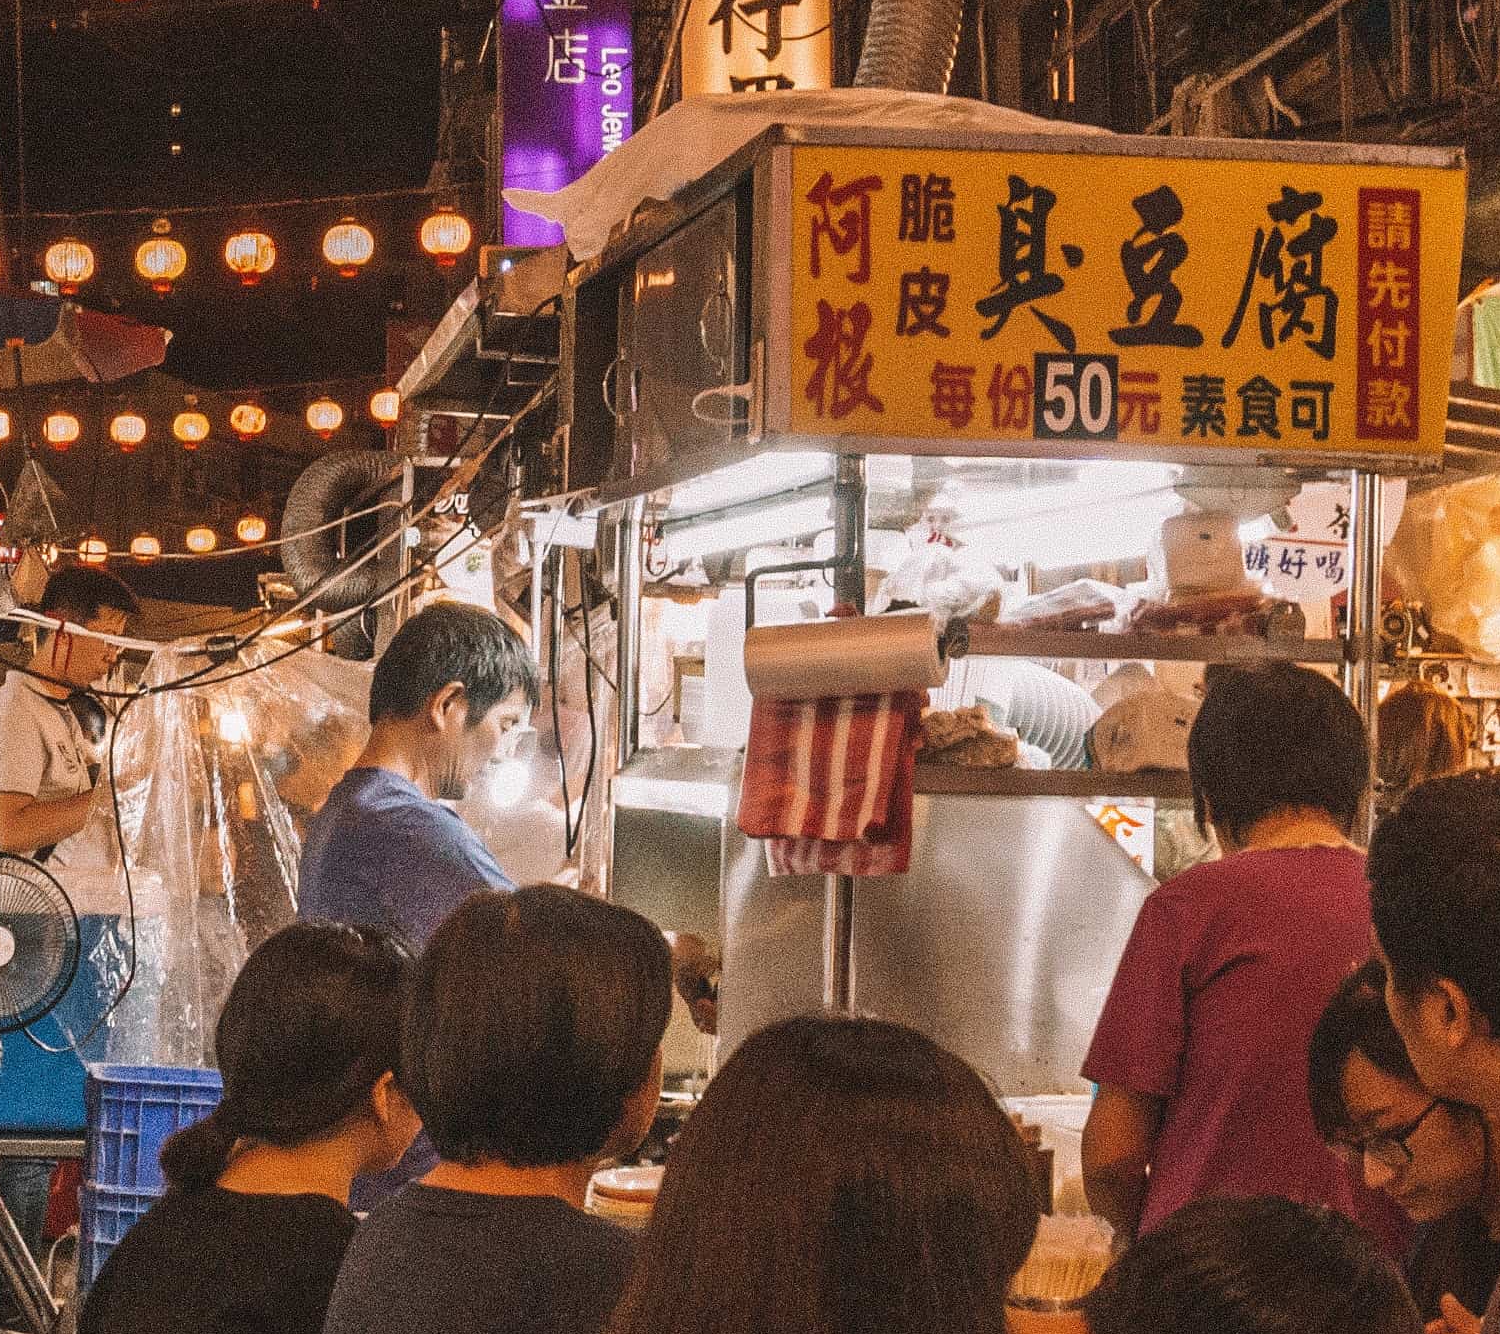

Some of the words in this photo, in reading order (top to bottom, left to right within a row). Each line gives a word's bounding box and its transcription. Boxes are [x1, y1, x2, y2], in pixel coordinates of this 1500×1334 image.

[600, 47, 629, 96] Leo
[802, 171, 884, 421] 阿根
[896, 173, 958, 339] 脆皮
[974, 173, 1341, 361] 臭豆腐
[1364, 201, 1414, 435] 請先付款
[930, 354, 1162, 441] 每份50元
[1181, 373, 1332, 441] 素食可
